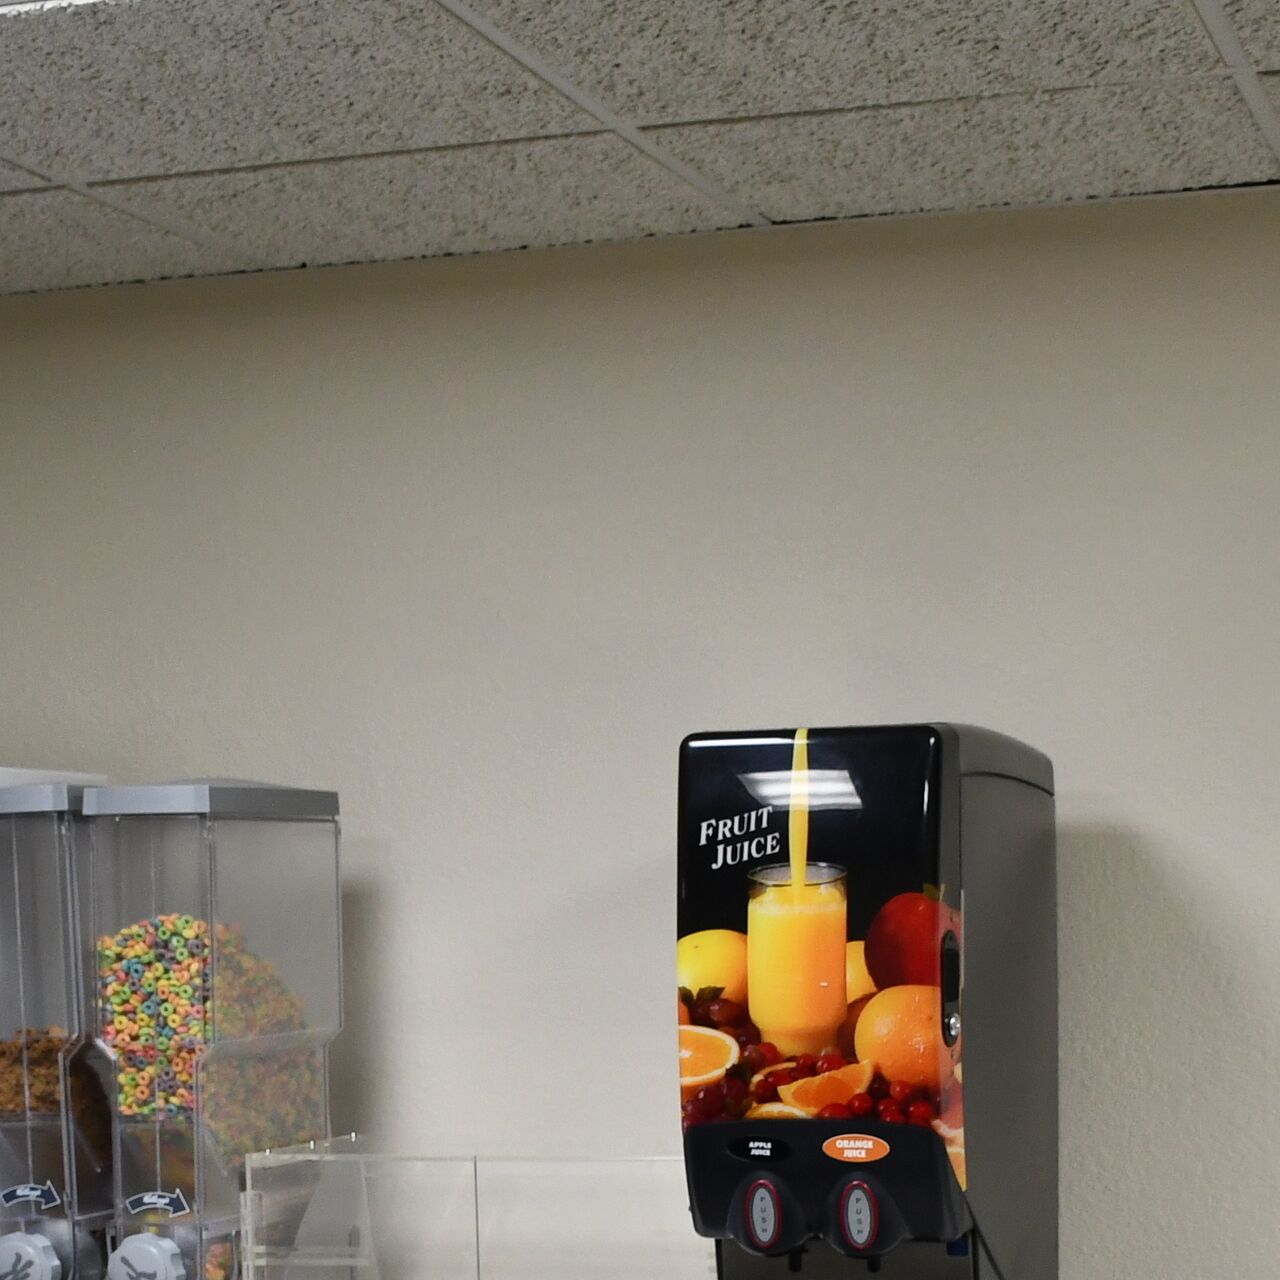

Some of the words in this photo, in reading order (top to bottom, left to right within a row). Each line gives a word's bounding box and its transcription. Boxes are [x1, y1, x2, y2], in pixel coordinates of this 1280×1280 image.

[699, 806, 773, 846] FRUIT
[711, 832, 780, 870] JUICE
[748, 1141, 772, 1149] APPLE
[750, 1149, 771, 1157] JUICE
[835, 1140, 873, 1149] ORANGE
[843, 1149, 866, 1158] JUICE
[759, 1197, 768, 1234] PUSH
[855, 1198, 864, 1235] PUSH
